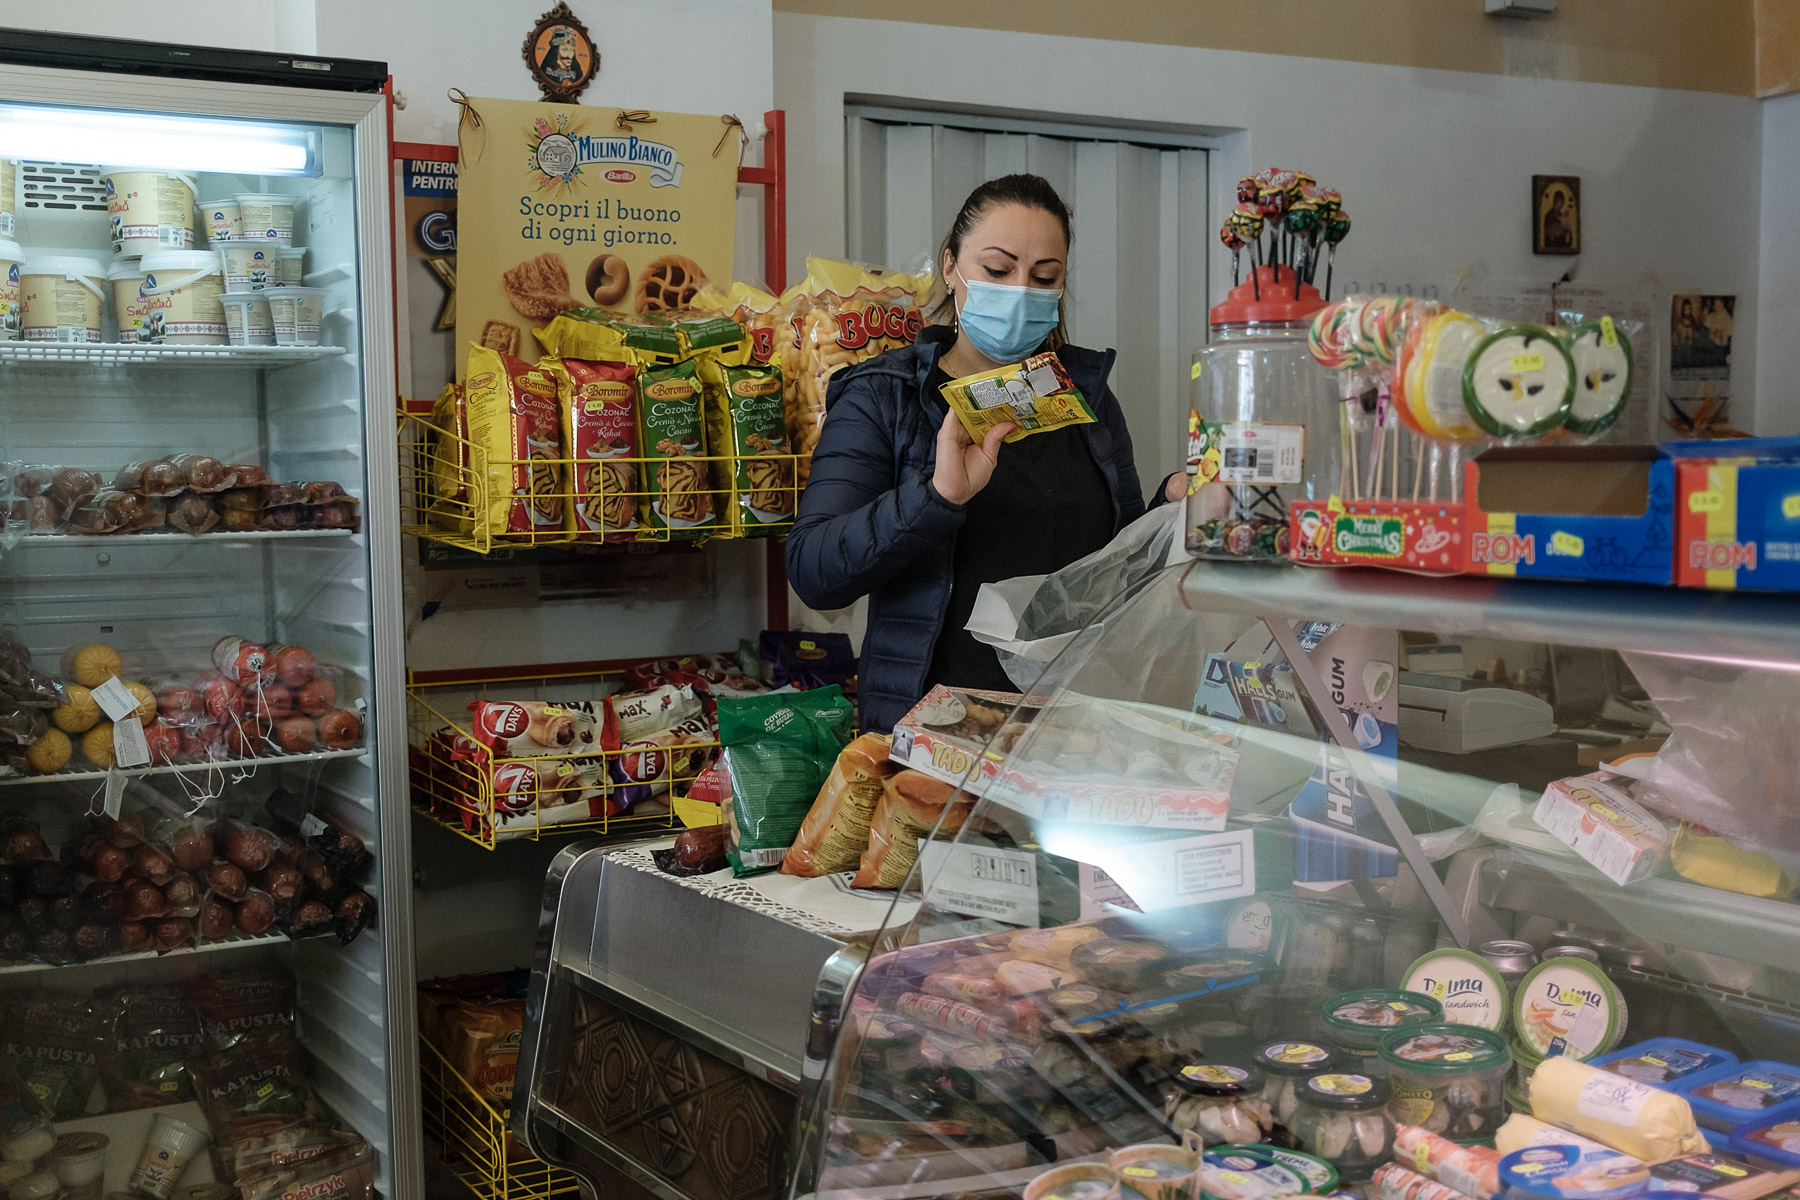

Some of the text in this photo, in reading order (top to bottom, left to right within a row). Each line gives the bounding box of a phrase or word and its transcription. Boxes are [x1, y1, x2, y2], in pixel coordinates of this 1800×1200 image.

[579, 135, 673, 167] MULINO BIANCO
[606, 171, 635, 182] Barilla
[519, 196, 681, 223] Scopri il buono
[521, 218, 678, 247] di ogni giorno.
[520, 376, 555, 393] Boromir
[585, 382, 629, 398] Boromir
[652, 380, 693, 397] Boromir
[1471, 532, 1535, 566] ROM
[1688, 539, 1757, 571] ROM
[1332, 657, 1345, 705] GUM
[506, 706, 524, 733] DAYS
[1087, 792, 1154, 825] TADU
[1423, 977, 1483, 994] Dlma
[7, 1042, 96, 1065] KAPUSTA
[116, 1032, 204, 1051] KAPUSTA
[211, 1064, 292, 1099] KAPUSTA
